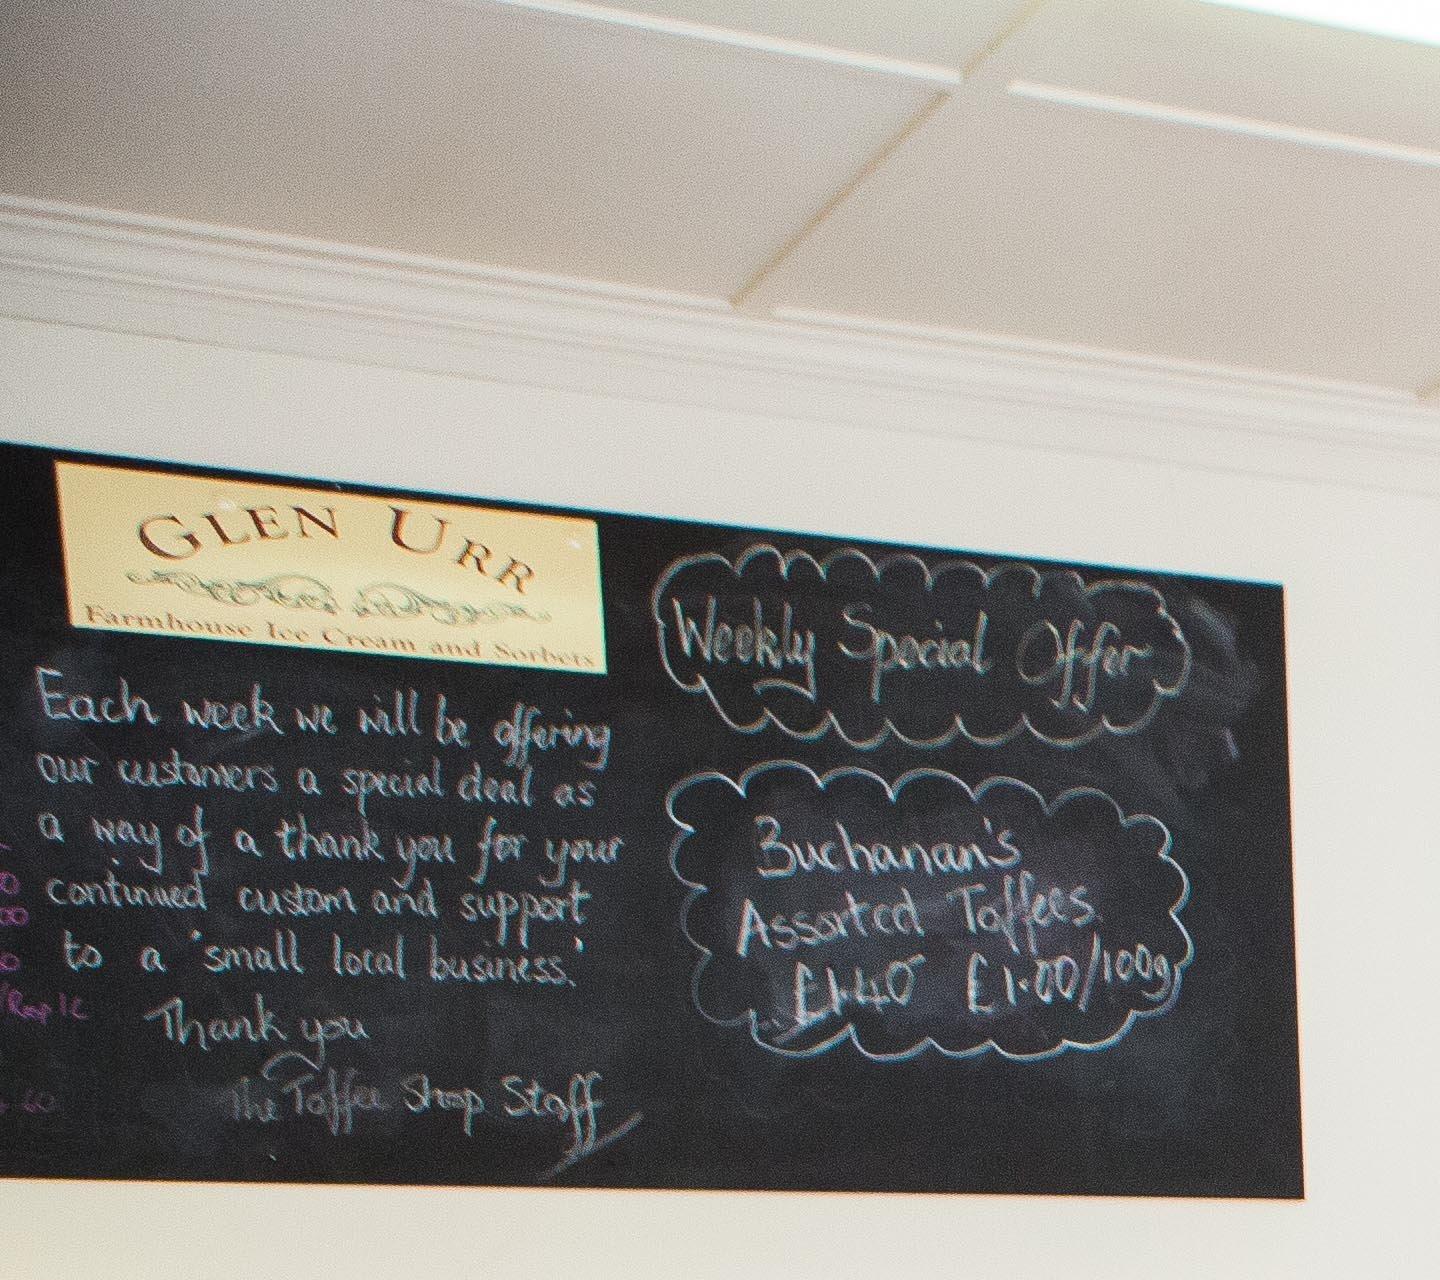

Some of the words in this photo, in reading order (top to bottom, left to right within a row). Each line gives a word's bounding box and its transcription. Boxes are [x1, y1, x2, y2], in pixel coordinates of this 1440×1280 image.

[137, 504, 340, 561] GLEN
[387, 507, 536, 595] URR
[85, 603, 250, 636] Farmhouse
[268, 621, 318, 643] Ice
[323, 625, 418, 654] Cream
[428, 637, 482, 659] and
[492, 642, 597, 668] Sorbets
[673, 597, 816, 702] Weekly
[841, 604, 993, 702] Special
[1017, 618, 1153, 712] Offer
[36, 666, 160, 724] Each
[185, 684, 285, 735] week
[297, 702, 336, 735] we
[358, 690, 421, 736] will
[436, 697, 470, 748] be
[494, 702, 611, 770] offering
[39, 753, 100, 783] our
[119, 750, 278, 793] customers
[301, 772, 321, 796] a
[343, 760, 444, 817] special
[457, 762, 532, 807] deal
[553, 781, 596, 807] as
[38, 814, 65, 842] a
[92, 819, 162, 875] way
[177, 804, 209, 875] of
[234, 830, 262, 859] a
[273, 815, 384, 862] thank
[395, 836, 455, 889] you
[469, 816, 529, 884] for
[539, 836, 624, 887] your
[756, 816, 1021, 878] Buchanan's
[46, 859, 208, 911] continued
[239, 886, 359, 918] custom
[372, 877, 439, 919] and
[459, 881, 593, 948] support
[738, 888, 925, 957] Assorted
[947, 872, 1096, 955] Toffees
[63, 931, 102, 971] to
[141, 943, 165, 973] a
[332, 933, 406, 980] local
[145, 993, 288, 1052] Thank
[301, 1015, 370, 1062] you
[283, 1067, 385, 1136] Toffee
[402, 1075, 485, 1136] Shop
[502, 1072, 603, 1151] Staff
